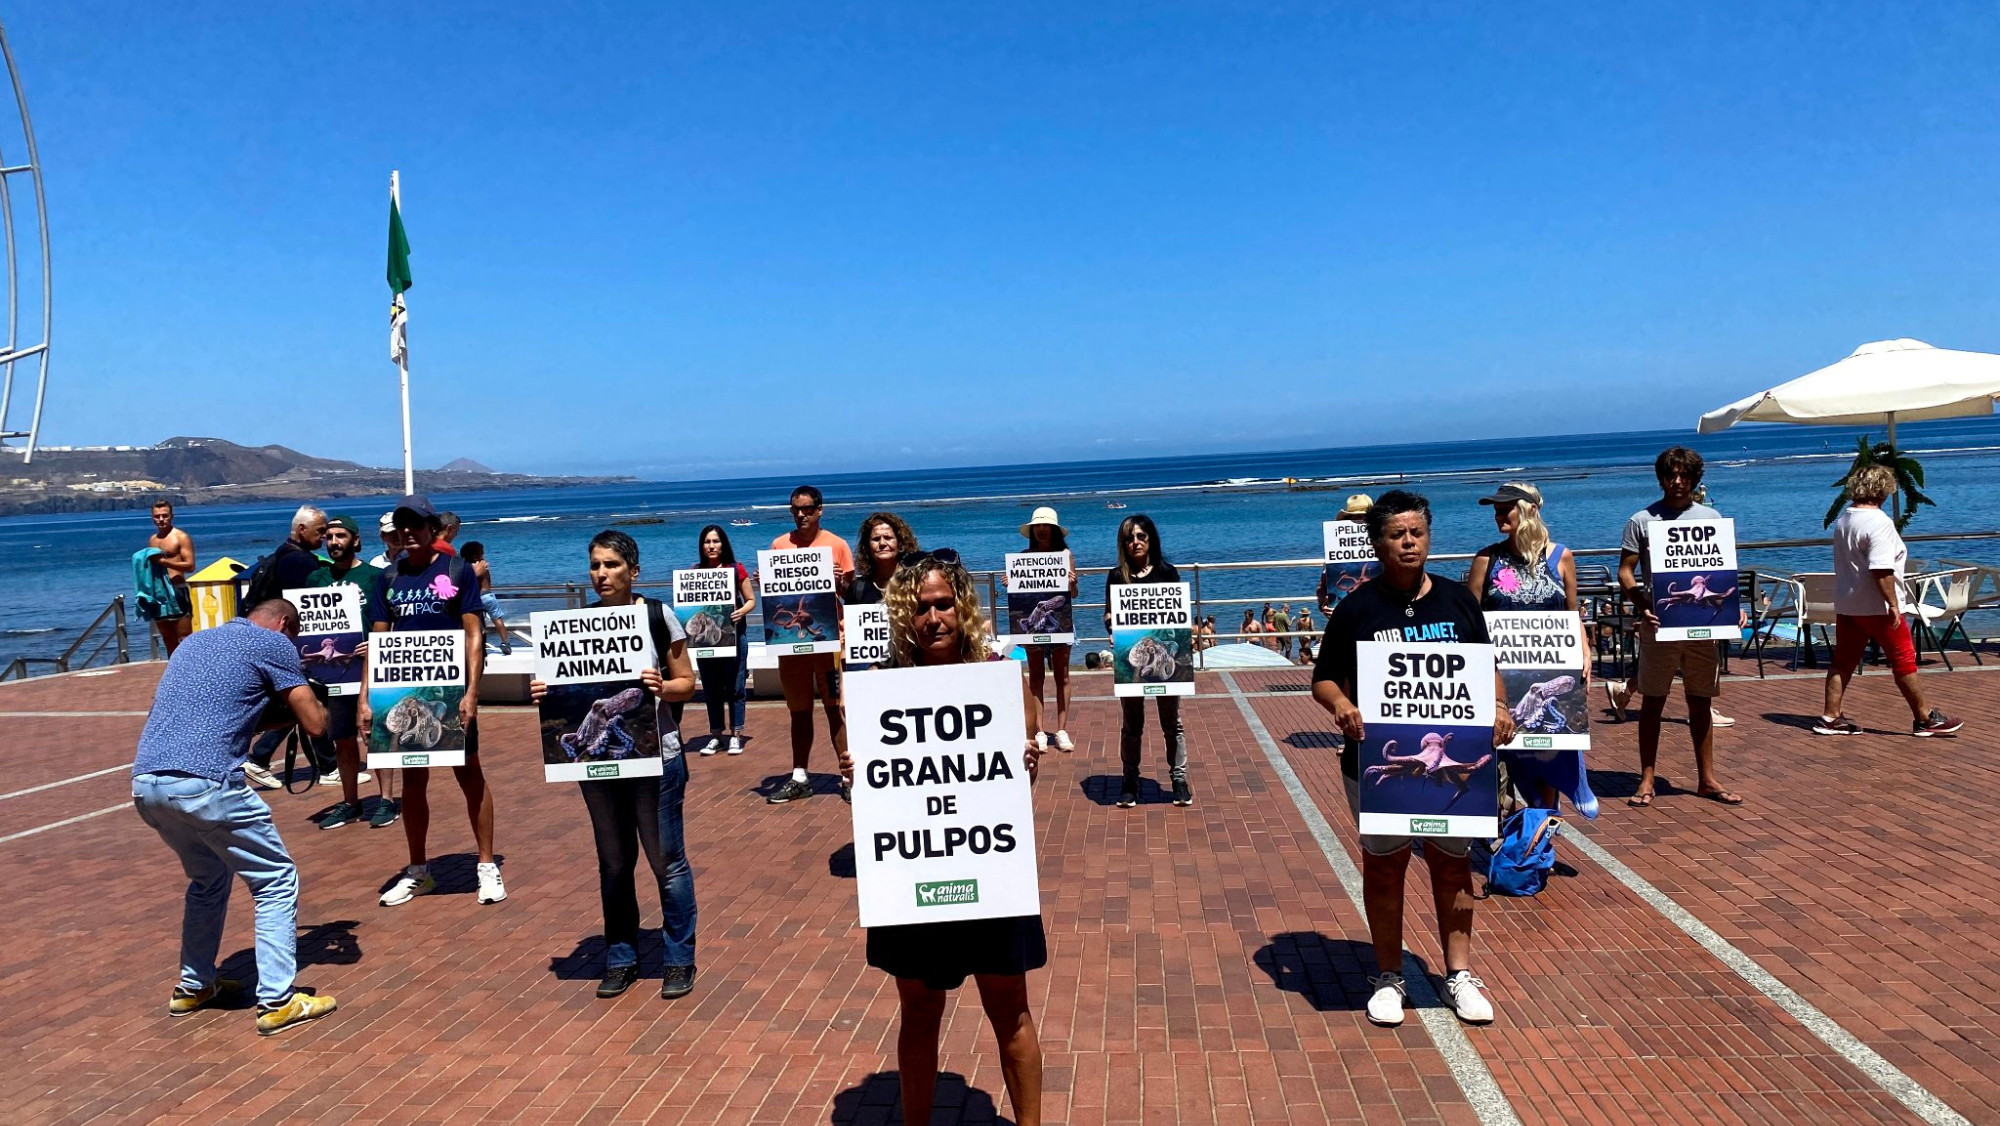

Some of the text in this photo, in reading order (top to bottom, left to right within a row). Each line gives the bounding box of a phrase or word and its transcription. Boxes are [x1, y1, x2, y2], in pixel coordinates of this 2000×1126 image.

[1335, 525, 1367, 537] ¡PELIG
[1668, 525, 1716, 543] STOP
[1329, 546, 1375, 560] ECOLÓG
[1665, 543, 1721, 557] GRANJA
[769, 552, 821, 568] ¡PELIGRO!
[1012, 555, 1063, 568] ¡ATENCIÓN!
[1664, 557, 1724, 568] DE PULPOS
[679, 571, 728, 581] LOS PULPOS
[774, 566, 819, 579] RIESGO
[1010, 568, 1067, 578] MALTRATO
[680, 580, 728, 591] MERECEN
[764, 578, 832, 593] ECOLÓGICO
[1018, 579, 1060, 589] ANIMAL
[677, 591, 732, 603] LIBERTAD
[1119, 587, 1182, 598] LOS PULPOS
[300, 592, 343, 609] STOP
[1120, 597, 1182, 611] MERECEN
[299, 608, 347, 622] GRANJA
[859, 611, 888, 627] ¡PEL
[1116, 611, 1188, 626] LIBERTAD
[299, 621, 350, 633] DE PULPOS
[544, 612, 636, 640] ¡ATENCIÓN!
[1404, 622, 1458, 641] PLANET,
[1488, 615, 1569, 633] ¡ATENCIÓN!
[379, 635, 454, 648] LOS PULPOS
[863, 627, 889, 641] RIE
[540, 635, 643, 658] MALTRATO
[850, 645, 889, 660] ECOL
[379, 649, 454, 665] MERECEN
[1498, 650, 1566, 664] ANIMAL
[555, 657, 632, 678] ANIMAL
[1388, 653, 1465, 678] STOP
[373, 665, 459, 683] LIBERTAD
[1383, 681, 1471, 701] GRANJA
[1381, 703, 1475, 720] DE PULPOS
[879, 703, 992, 745] STOP
[866, 751, 1014, 789] GRANJA
[926, 795, 957, 816] DE
[873, 823, 1017, 862] PULPOS
[937, 882, 974, 895] anima
[937, 892, 975, 903] naturalis
